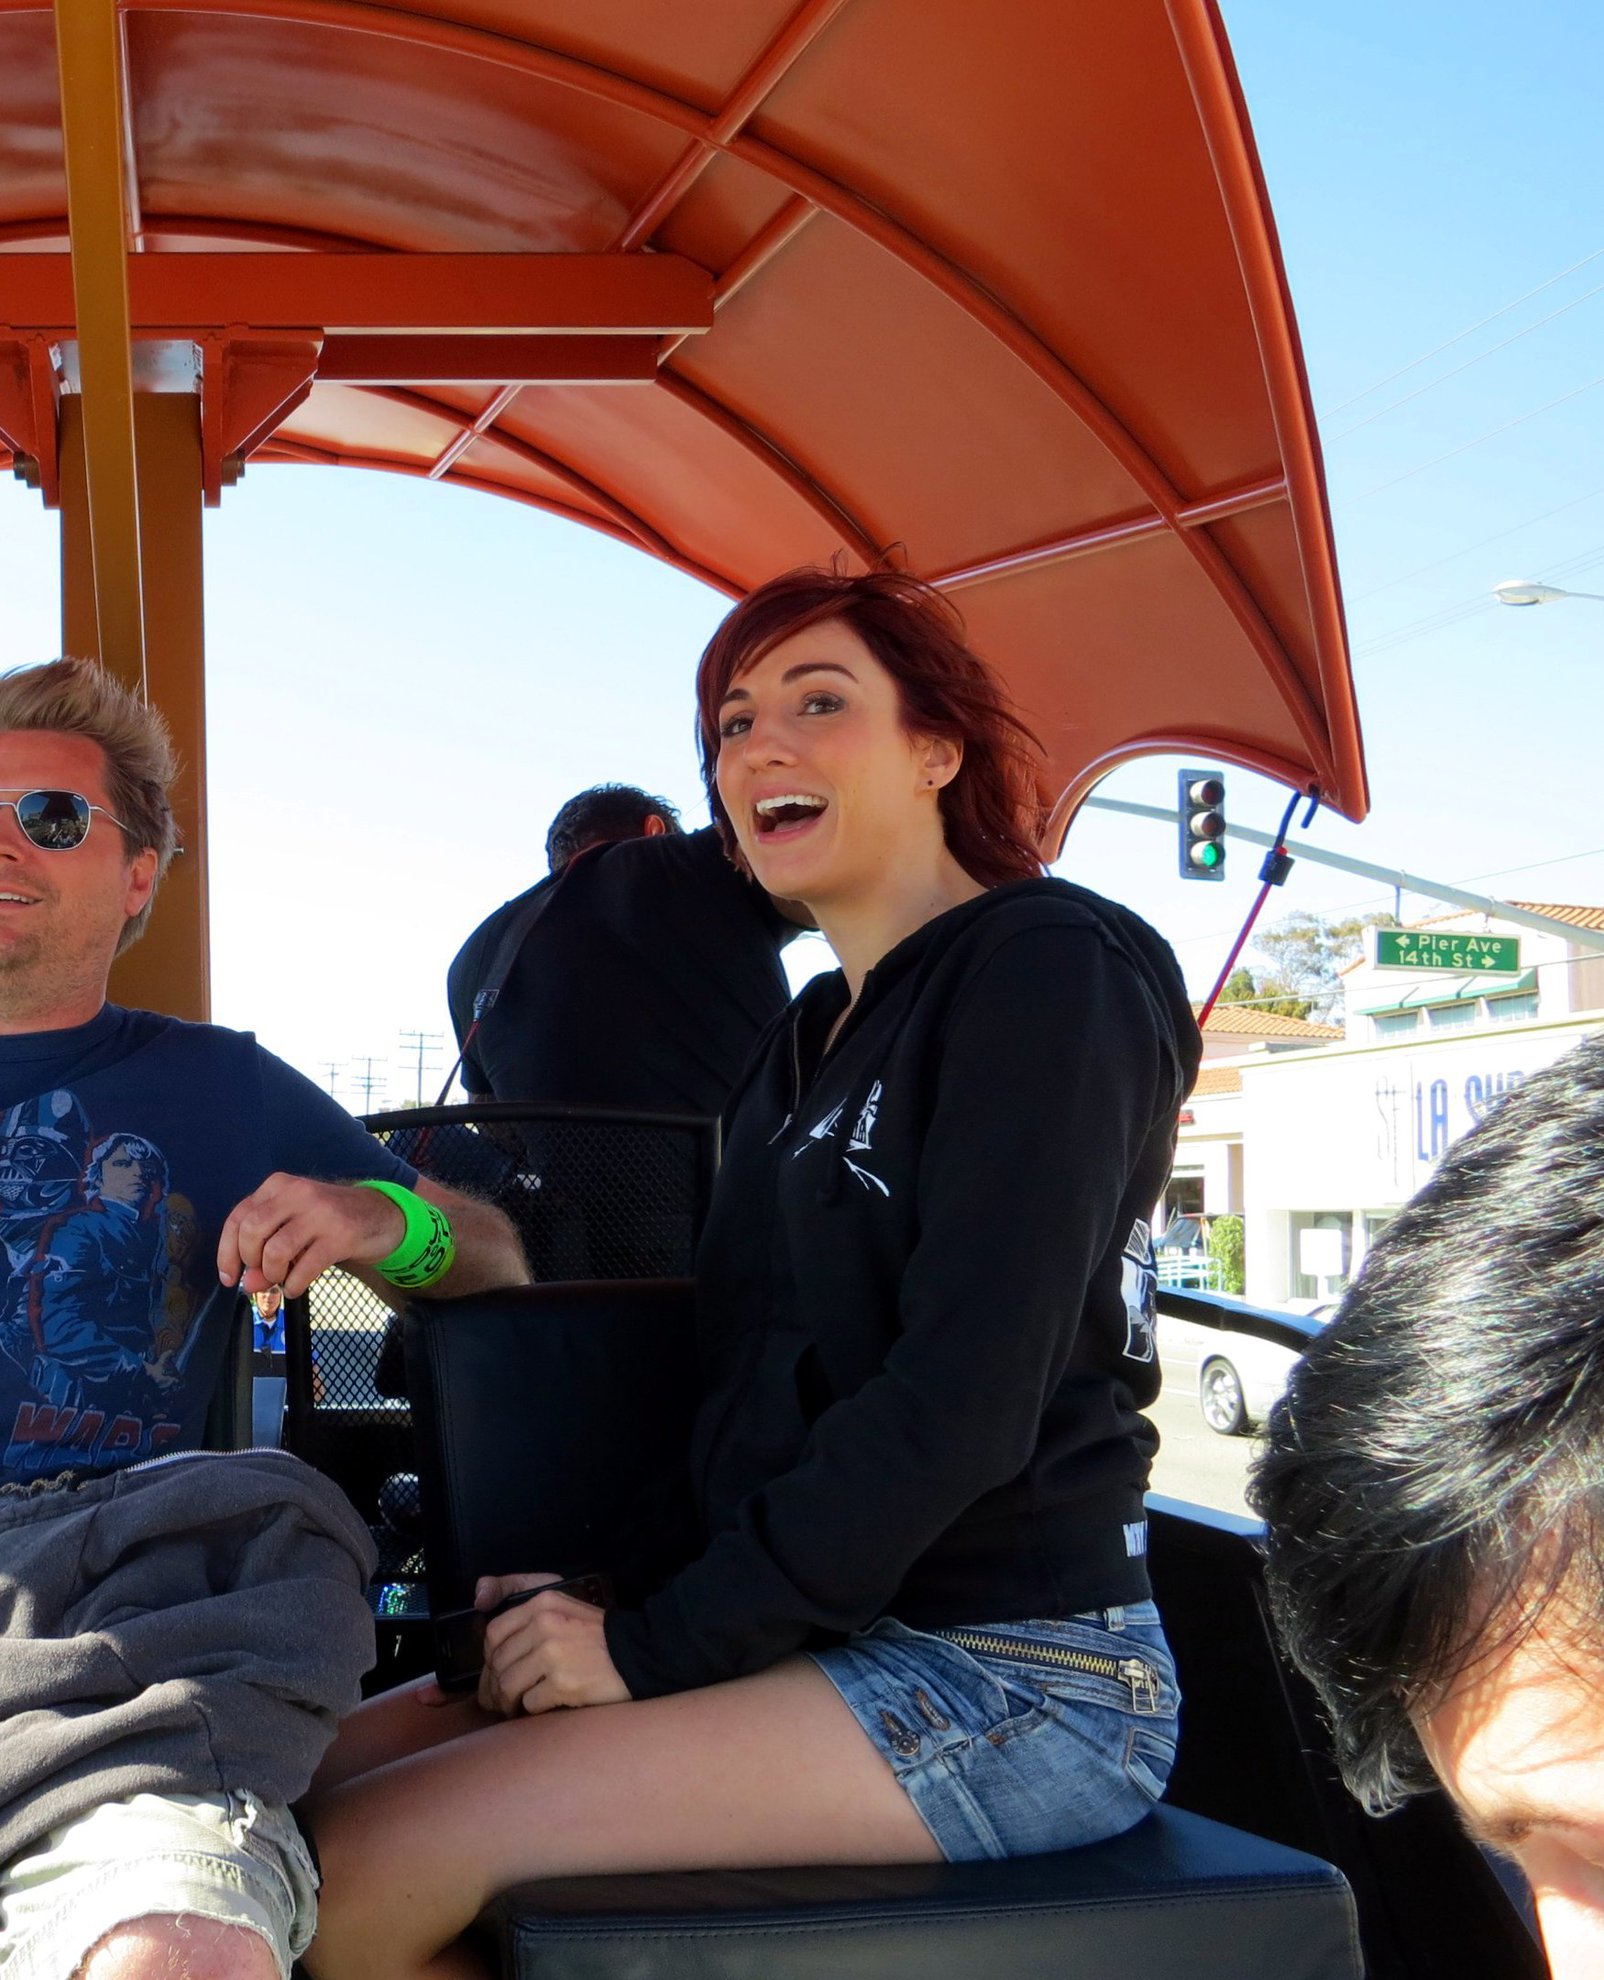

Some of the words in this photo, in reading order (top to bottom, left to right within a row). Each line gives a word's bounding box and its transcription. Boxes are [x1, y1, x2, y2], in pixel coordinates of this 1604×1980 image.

[1418, 935, 1459, 951] Pier
[1466, 938, 1502, 953] Ave
[1399, 950, 1442, 966] 14th
[1451, 953, 1473, 968] St
[1416, 1079, 1449, 1161] LA
